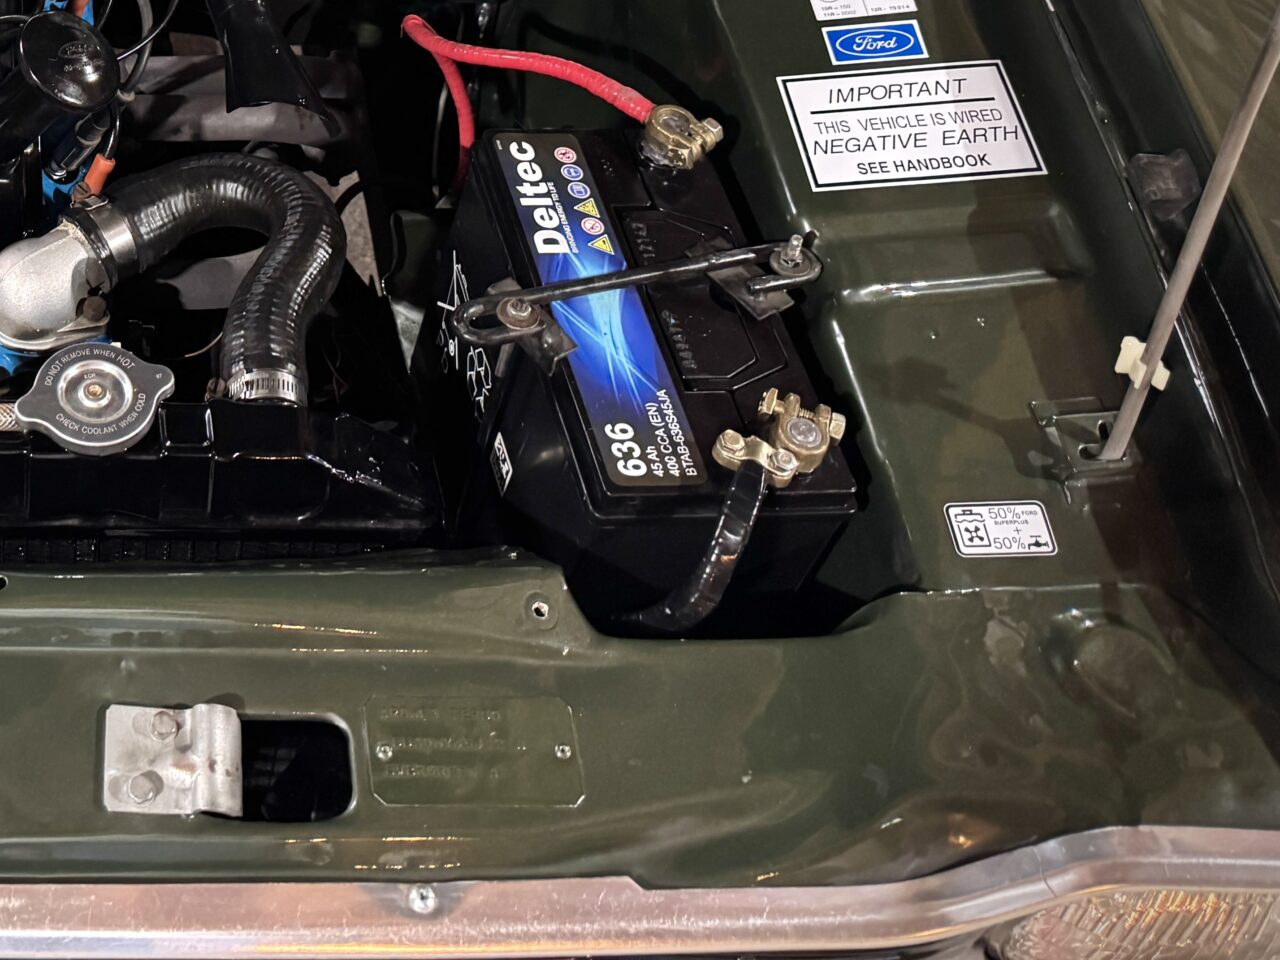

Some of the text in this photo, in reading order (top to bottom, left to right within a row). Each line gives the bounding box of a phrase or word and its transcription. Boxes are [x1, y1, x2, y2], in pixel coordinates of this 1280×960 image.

[853, 34, 897, 52] Ford
[828, 78, 967, 104] IMPORTANT
[813, 108, 1003, 135] THIS VEHICLE IS WIRED
[813, 125, 1019, 156] NEGATIVE EARTH
[857, 153, 992, 175] SEE HANDBOOK
[509, 140, 570, 254] Deltec
[45, 348, 136, 386] DO NOT REMOVE WHEN HOT
[55, 393, 146, 435] CHECK COOLANT WHEN COLD
[645, 402, 666, 427] (EN)
[604, 422, 648, 477] 636
[655, 428, 673, 454] CCA
[646, 446, 665, 477] 45 Ah
[988, 507, 1021, 520] 50%
[994, 537, 1026, 550] 50%
